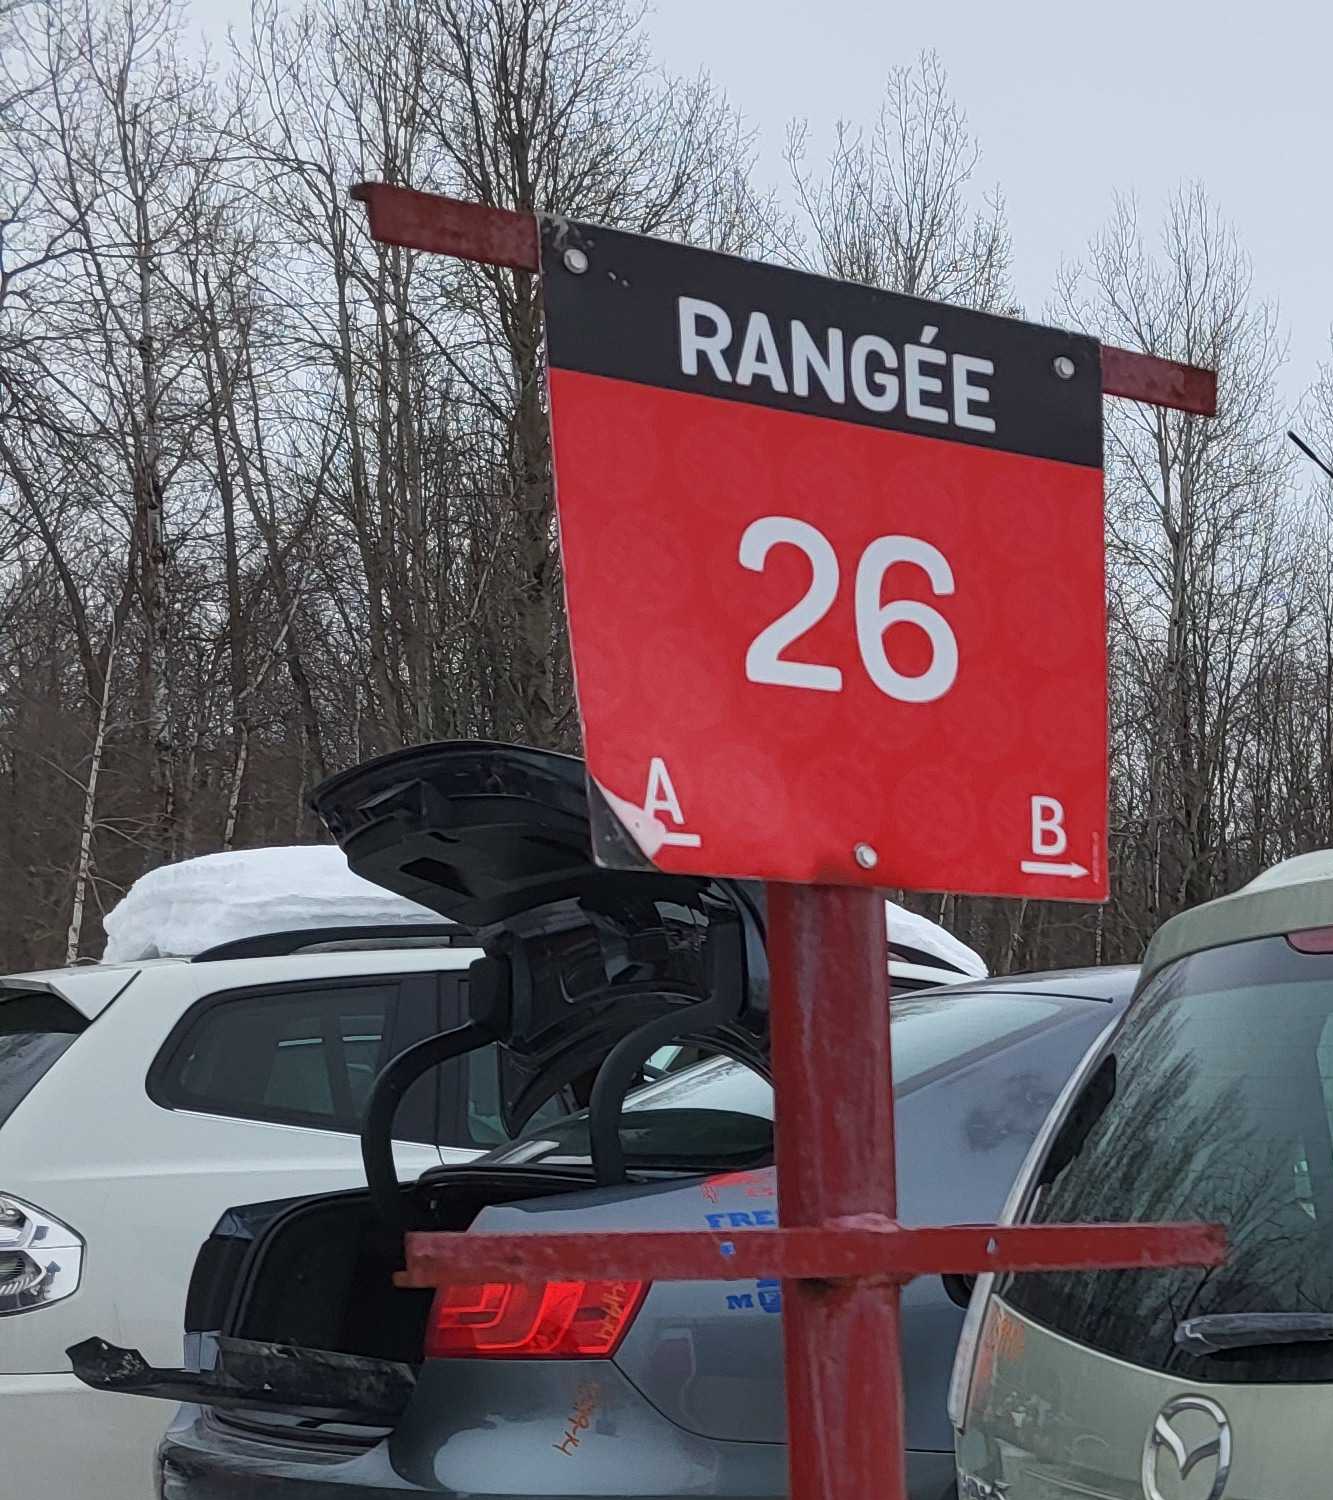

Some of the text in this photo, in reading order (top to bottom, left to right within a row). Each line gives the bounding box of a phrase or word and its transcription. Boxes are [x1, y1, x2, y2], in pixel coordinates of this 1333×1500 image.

[677, 295, 997, 434] RANGÉE
[738, 515, 959, 703] 26
[643, 756, 685, 825] A
[1030, 795, 1067, 856] B
[703, 1210, 777, 1229] FRE
